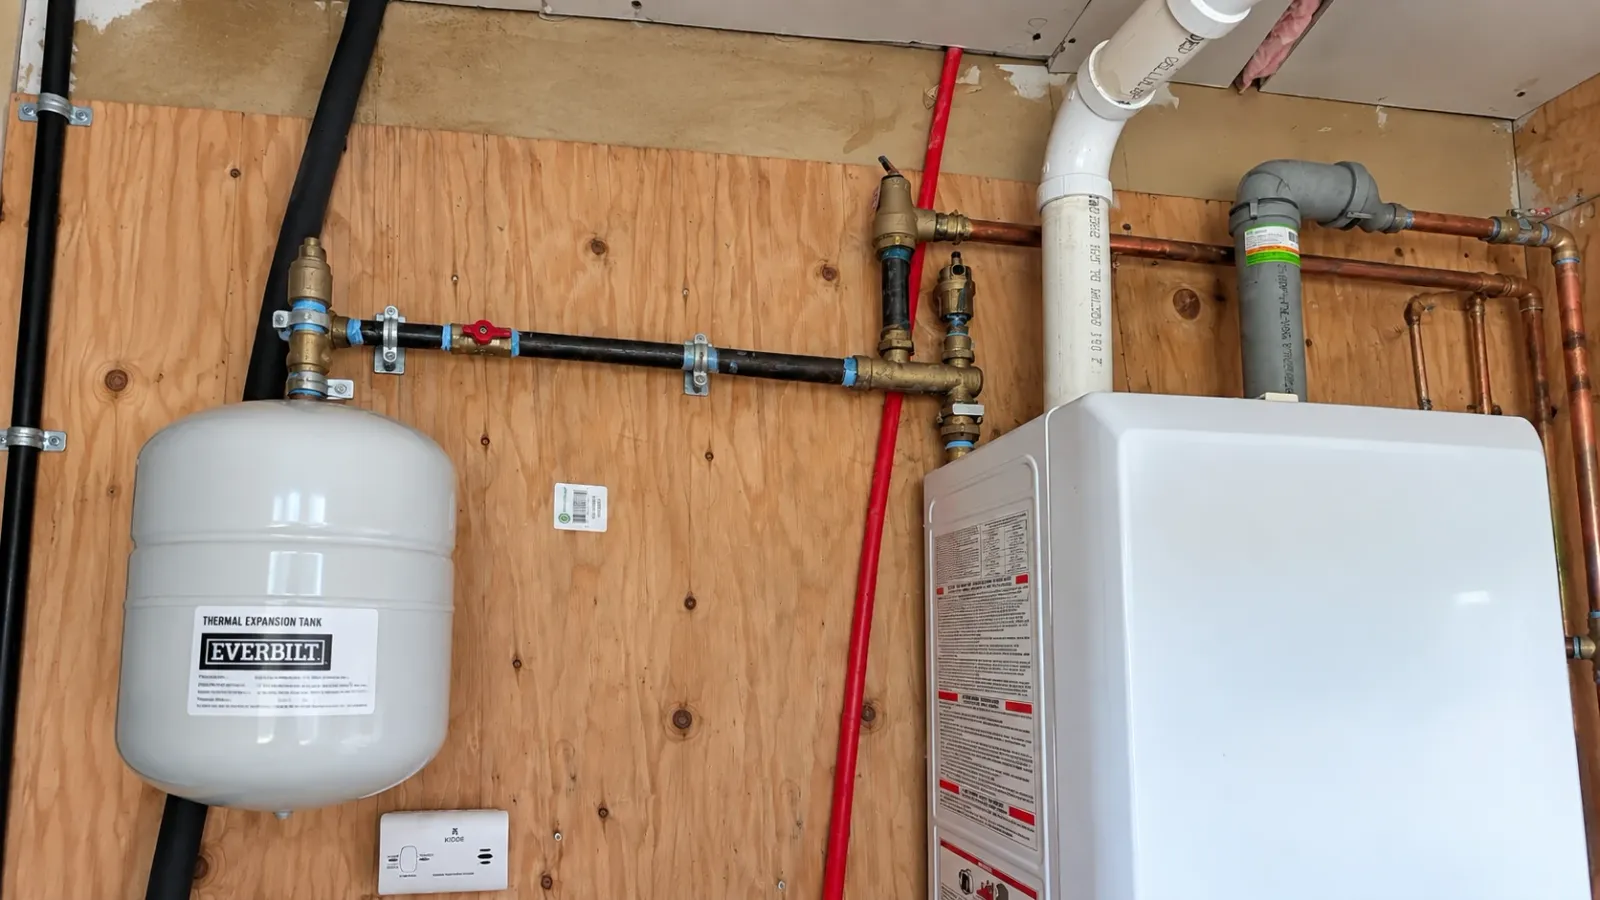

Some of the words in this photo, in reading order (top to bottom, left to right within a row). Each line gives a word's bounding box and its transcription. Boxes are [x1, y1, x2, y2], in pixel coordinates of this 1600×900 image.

[203, 616, 242, 626] THERMAL
[245, 616, 296, 627] EXPANSION
[299, 617, 322, 627] TANK
